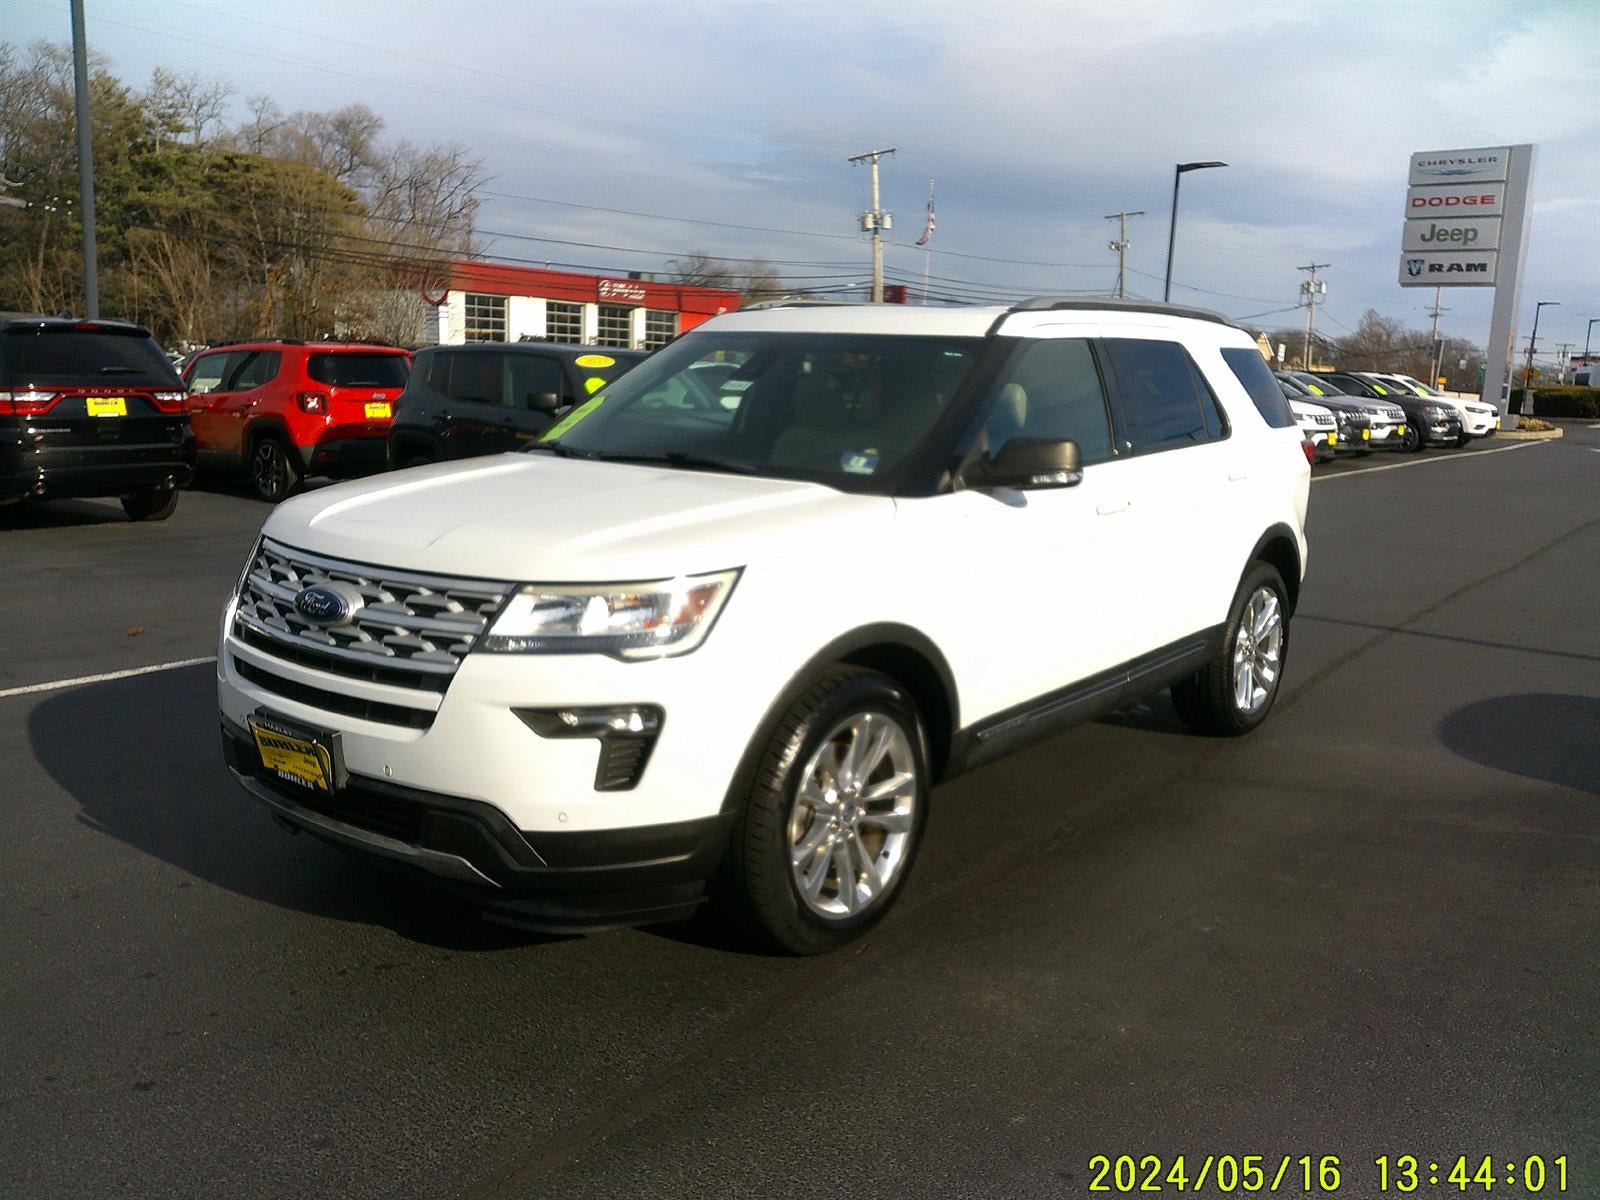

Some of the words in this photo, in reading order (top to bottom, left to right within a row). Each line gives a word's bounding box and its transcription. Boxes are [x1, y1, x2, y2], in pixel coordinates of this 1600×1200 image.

[1417, 156, 1498, 167] CHRYSLER
[1411, 195, 1496, 208] DODGE
[1420, 224, 1478, 246] Jeep
[1428, 262, 1488, 272] RAM
